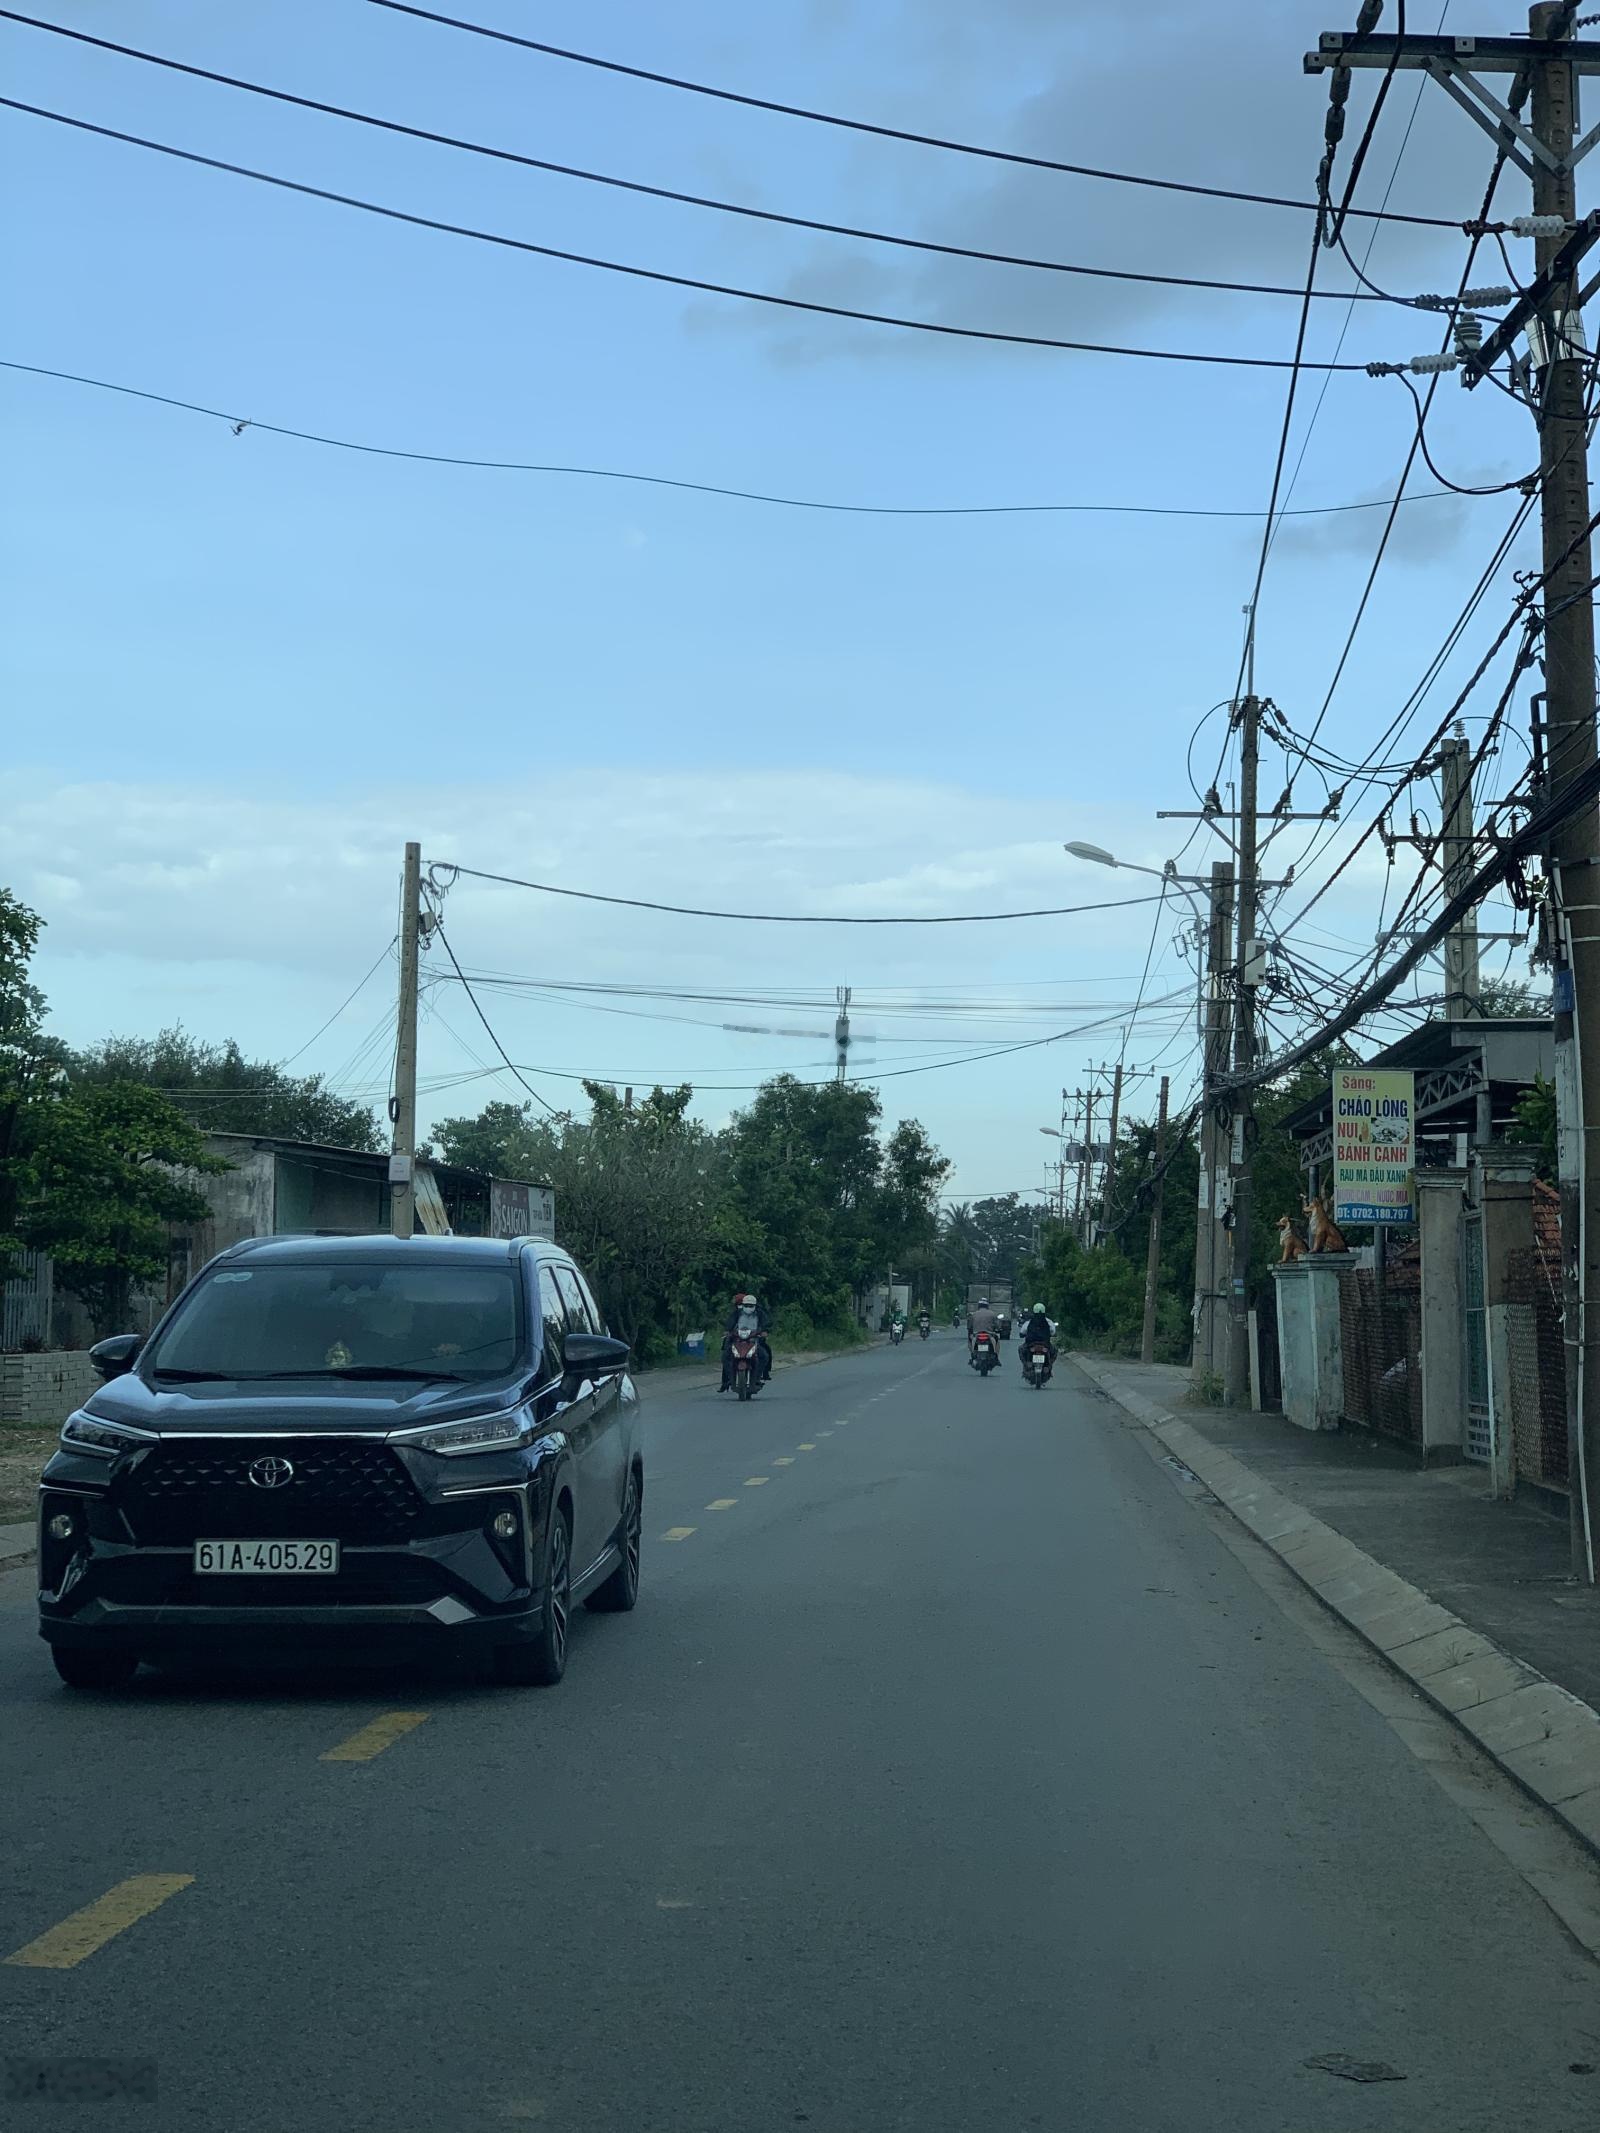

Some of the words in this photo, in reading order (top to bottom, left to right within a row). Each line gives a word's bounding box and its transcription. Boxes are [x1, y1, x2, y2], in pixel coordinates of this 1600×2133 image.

[1342, 1075, 1376, 1091] Sáng:
[1338, 1095, 1371, 1117] CHÁO
[1375, 1095, 1408, 1118] LÒNG
[1337, 1122, 1359, 1139] NUI
[1337, 1142, 1371, 1162] BÁNH
[1374, 1146, 1408, 1163] CANH
[1340, 1169, 1354, 1182] RAU
[1386, 1169, 1407, 1183] XANH
[1352, 1207, 1409, 1220] 0702.180.797
[200, 1544, 332, 1570] 61A-405.29
